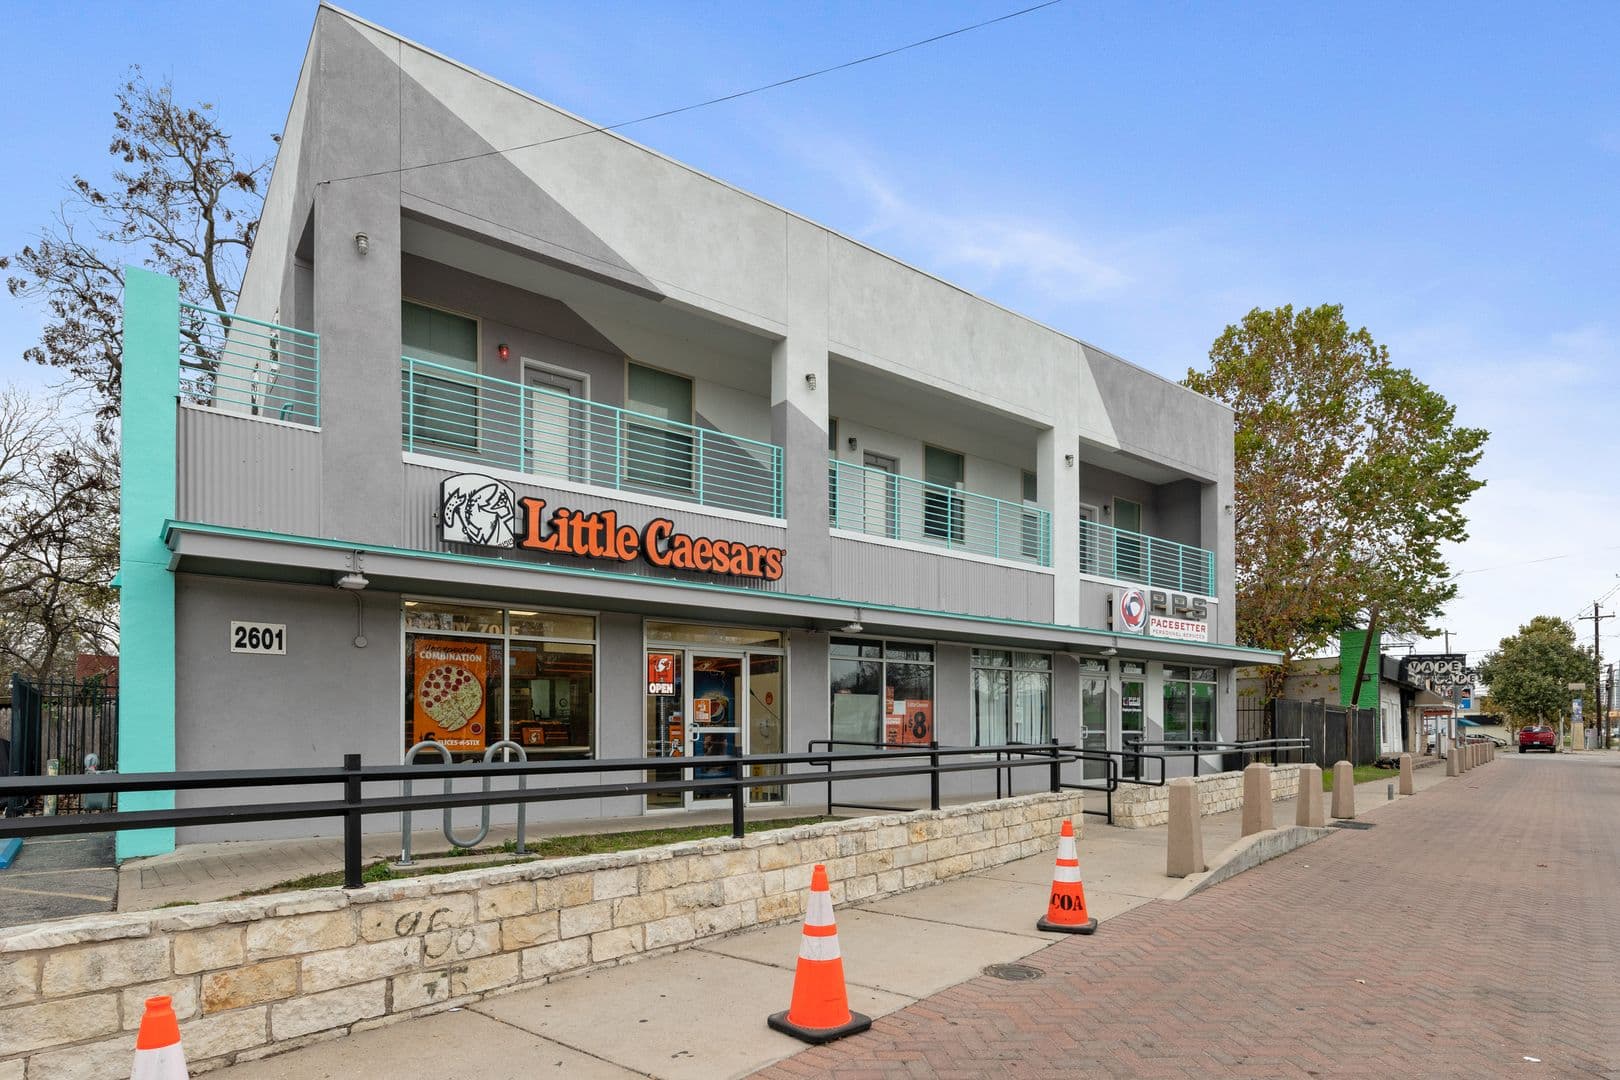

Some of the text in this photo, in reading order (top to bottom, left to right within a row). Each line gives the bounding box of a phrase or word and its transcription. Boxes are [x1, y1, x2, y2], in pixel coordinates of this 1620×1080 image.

[520, 496, 783, 581] Little Caesars
[1150, 590, 1208, 620] PPS
[479, 623, 520, 635] ZOE
[1151, 618, 1206, 633] PACESETTER
[234, 626, 283, 651] 2601
[420, 651, 482, 662] COMBINATION
[1408, 661, 1462, 673] VAPE
[649, 683, 674, 694] OPEN
[1050, 893, 1083, 911] COA
